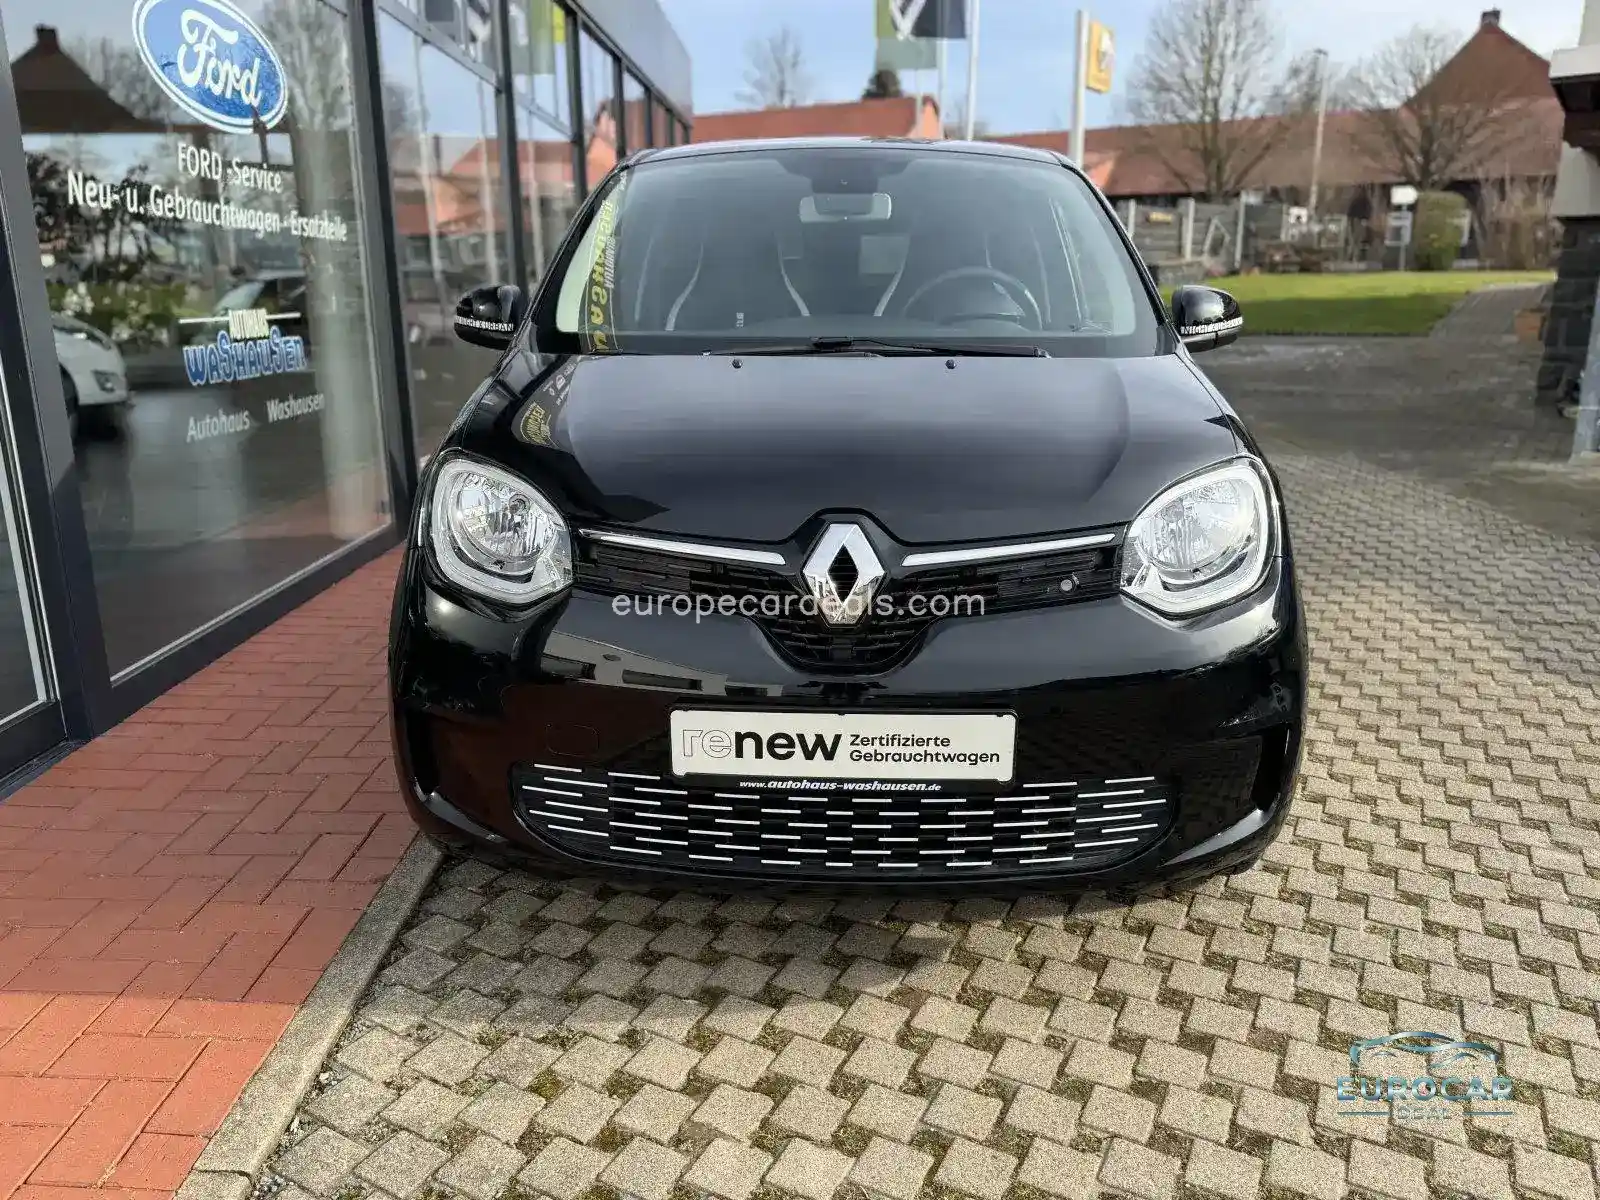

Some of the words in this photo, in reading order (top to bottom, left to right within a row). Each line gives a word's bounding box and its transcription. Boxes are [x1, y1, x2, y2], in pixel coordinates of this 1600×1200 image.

[177, 9, 261, 107] Ford
[177, 141, 222, 180] FORD
[125, 186, 145, 214] u.
[186, 408, 250, 443] Autohaus
[267, 392, 325, 423] Washausen
[682, 729, 842, 761] renew
[849, 733, 951, 748] Zertifizierte
[849, 749, 1001, 766] Gebrauchtwagen
[739, 778, 942, 793] www.autohaus-washausen.de
